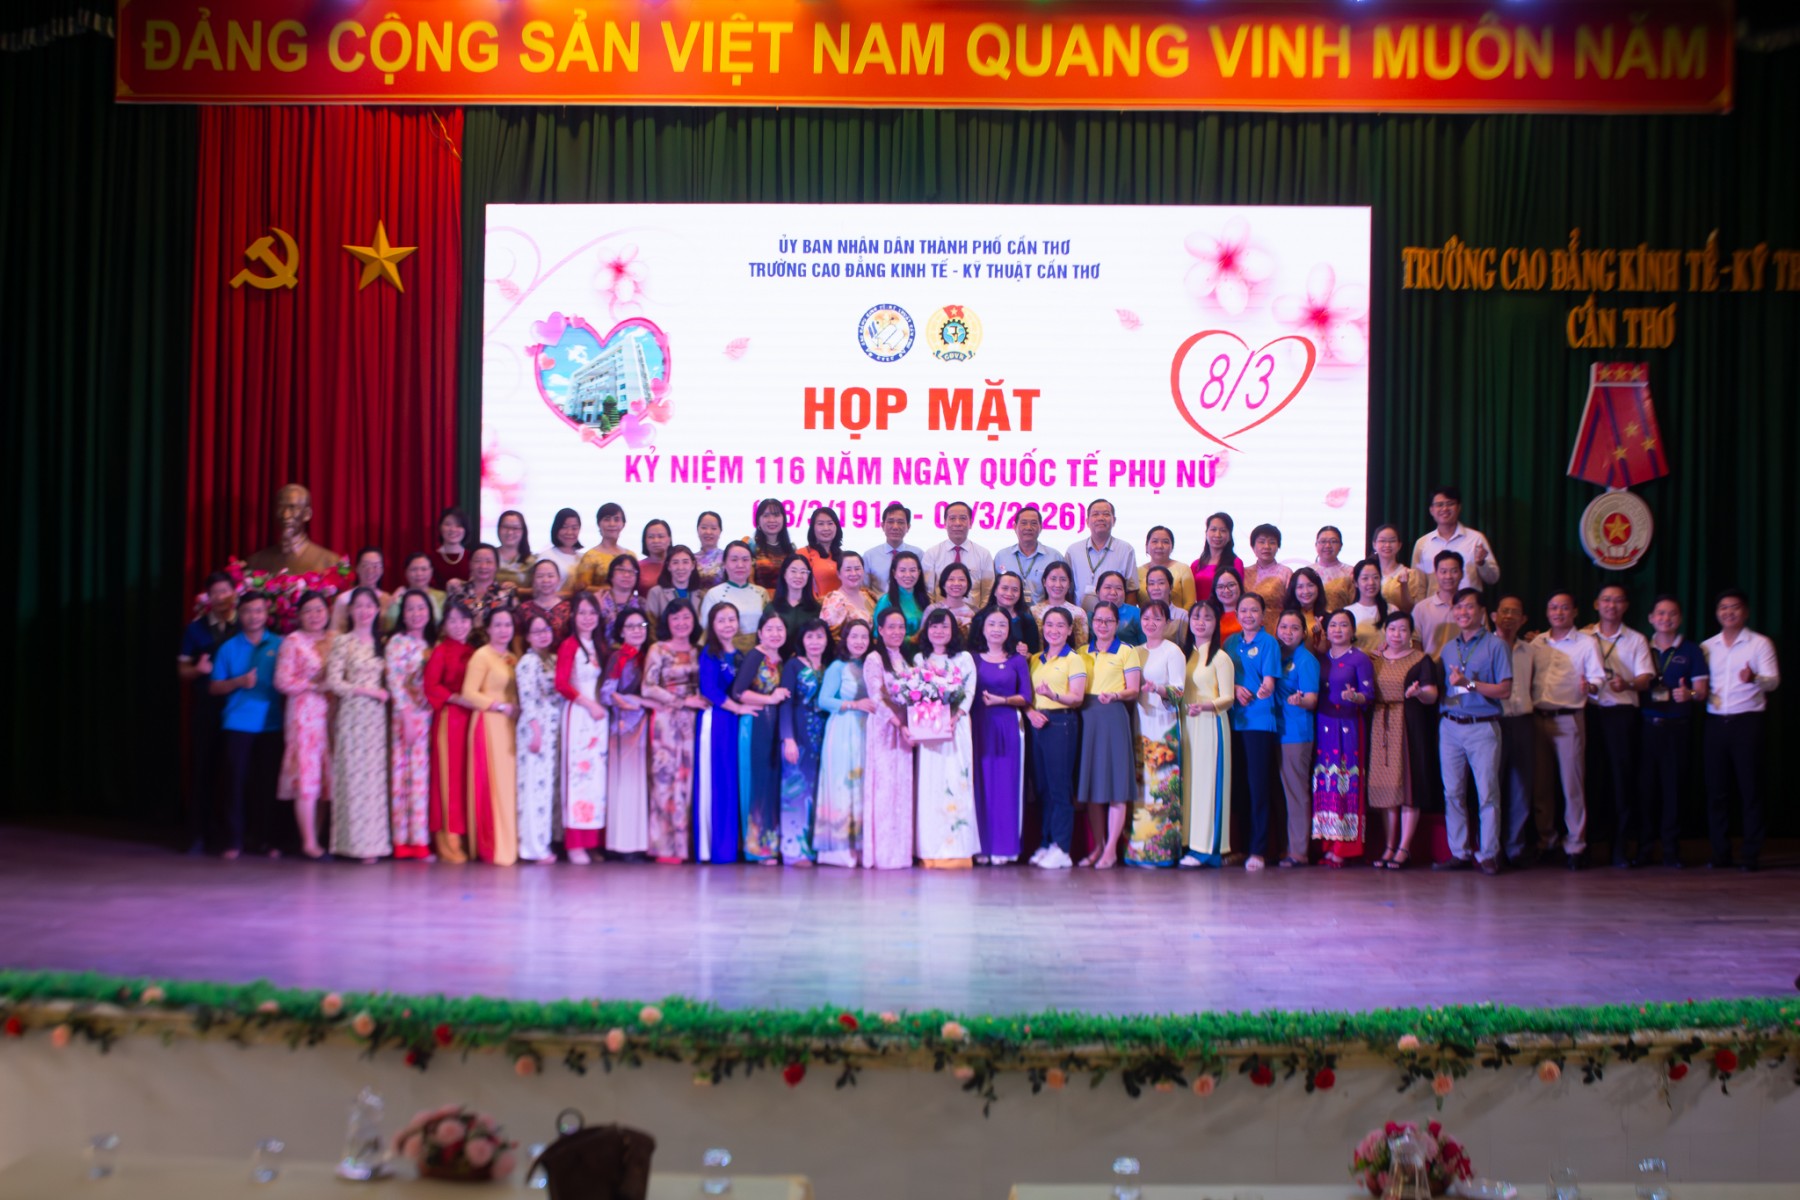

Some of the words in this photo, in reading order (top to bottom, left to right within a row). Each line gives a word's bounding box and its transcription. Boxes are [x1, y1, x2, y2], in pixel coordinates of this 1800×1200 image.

[141, 7, 309, 72] ĐẢNG
[328, 12, 499, 85] CỘNG
[519, 9, 640, 73] SẢN
[661, 12, 794, 86] VIỆT
[813, 22, 946, 76] NAM
[966, 22, 1190, 80] QUANG
[1208, 23, 1351, 79] VINH
[1373, 11, 1554, 80] MUÔN
[1574, 11, 1708, 80] NĂM
[748, 258, 807, 278] TRƯỜNG
[811, 262, 841, 278] CAO
[845, 255, 886, 278] ĐẲNG
[891, 263, 926, 278] KINH
[931, 258, 949, 278] TẾ
[963, 260, 982, 279] KỸ
[986, 261, 1033, 283] THUẬT
[1072, 262, 1101, 280] THƠ
[779, 234, 798, 254] ỦY
[803, 239, 833, 254] BAN
[837, 236, 879, 254] NHÂN
[884, 236, 915, 254] DÂN
[919, 236, 968, 255] THÀNH
[972, 235, 1002, 255] PHỐ
[1042, 239, 1071, 256] THƠ
[1500, 248, 1549, 292] CAO
[1622, 301, 1678, 350] THƠ
[1199, 351, 1275, 412] 8/3
[803, 386, 908, 440] HỌP
[928, 379, 1041, 441] MẶT
[625, 445, 660, 483] KỶ
[670, 450, 744, 490] NIỆM
[755, 456, 805, 485] 116
[816, 450, 882, 485] NĂM
[893, 451, 970, 487] NGÀY
[980, 448, 1057, 490] QUỐC
[1066, 450, 1101, 487] TẾ
[1109, 459, 1166, 494] PHỤ
[1177, 454, 1220, 489] NỮ
